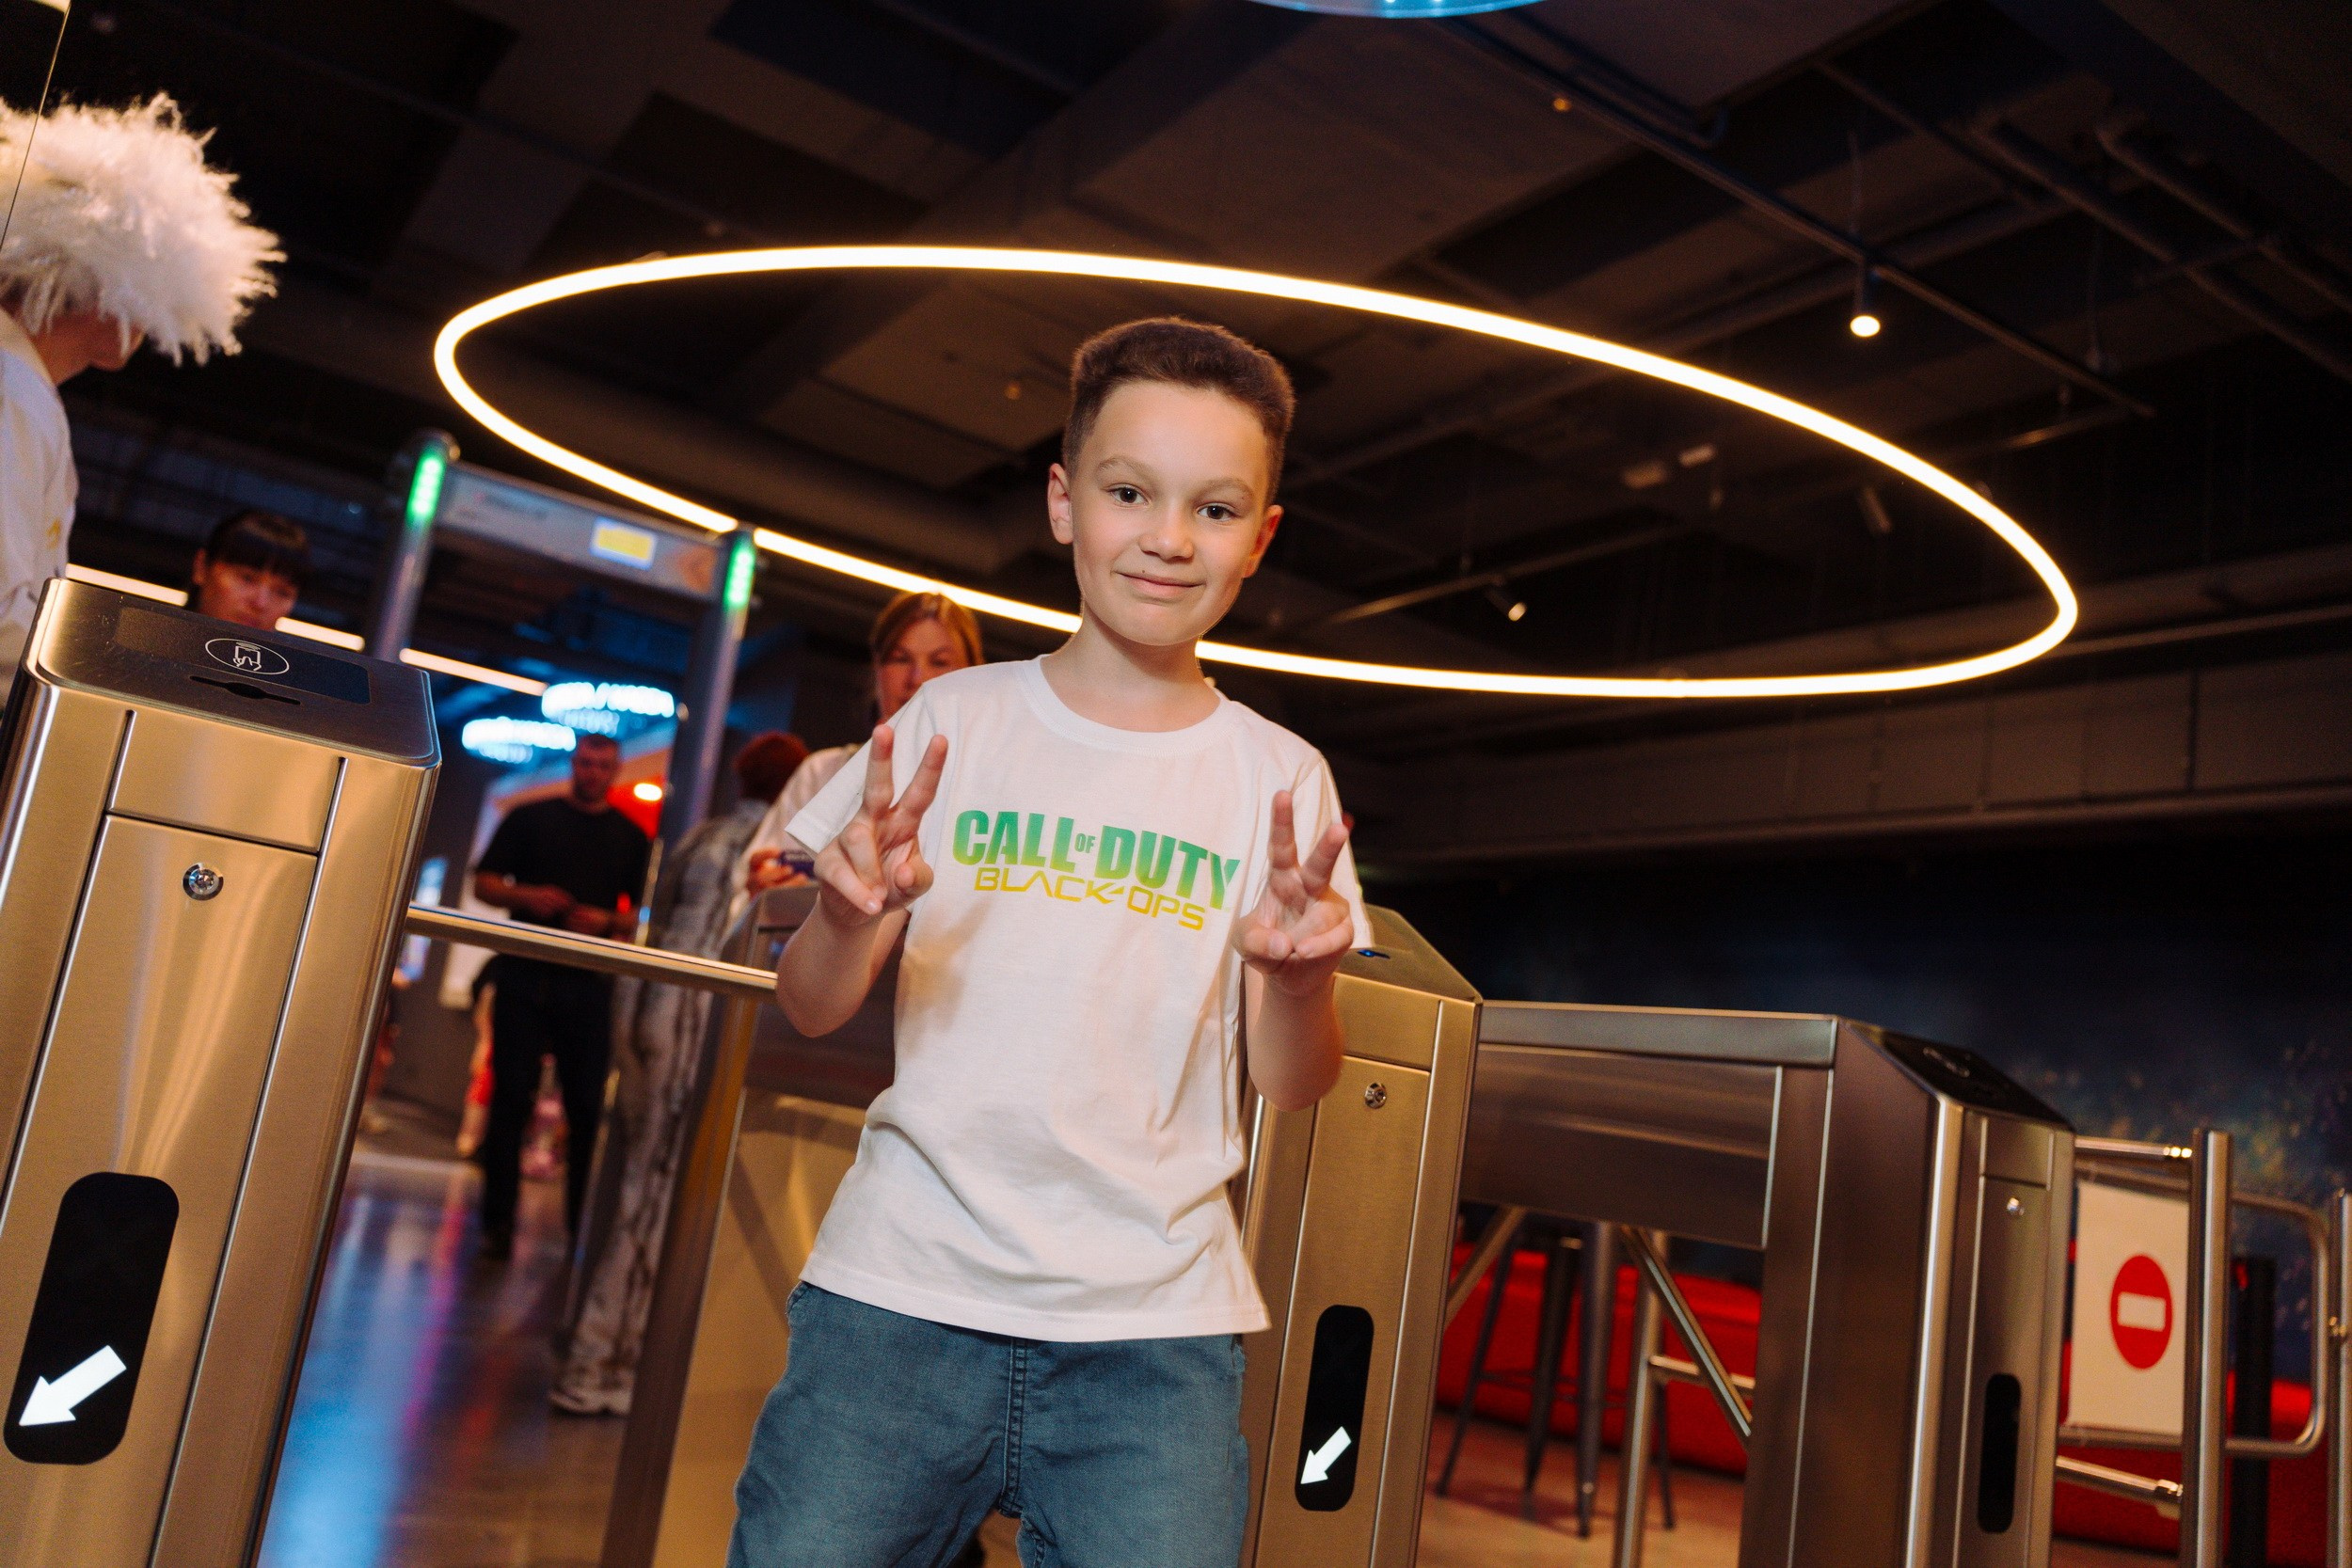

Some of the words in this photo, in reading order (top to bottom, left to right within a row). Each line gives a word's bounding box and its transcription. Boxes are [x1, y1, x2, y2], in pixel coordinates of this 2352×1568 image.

[952, 810, 1075, 873] CALL
[1074, 832, 1096, 853] OF
[1094, 825, 1240, 910] DUTY
[974, 867, 1123, 904] BLACK
[1127, 885, 1206, 930] OPS
